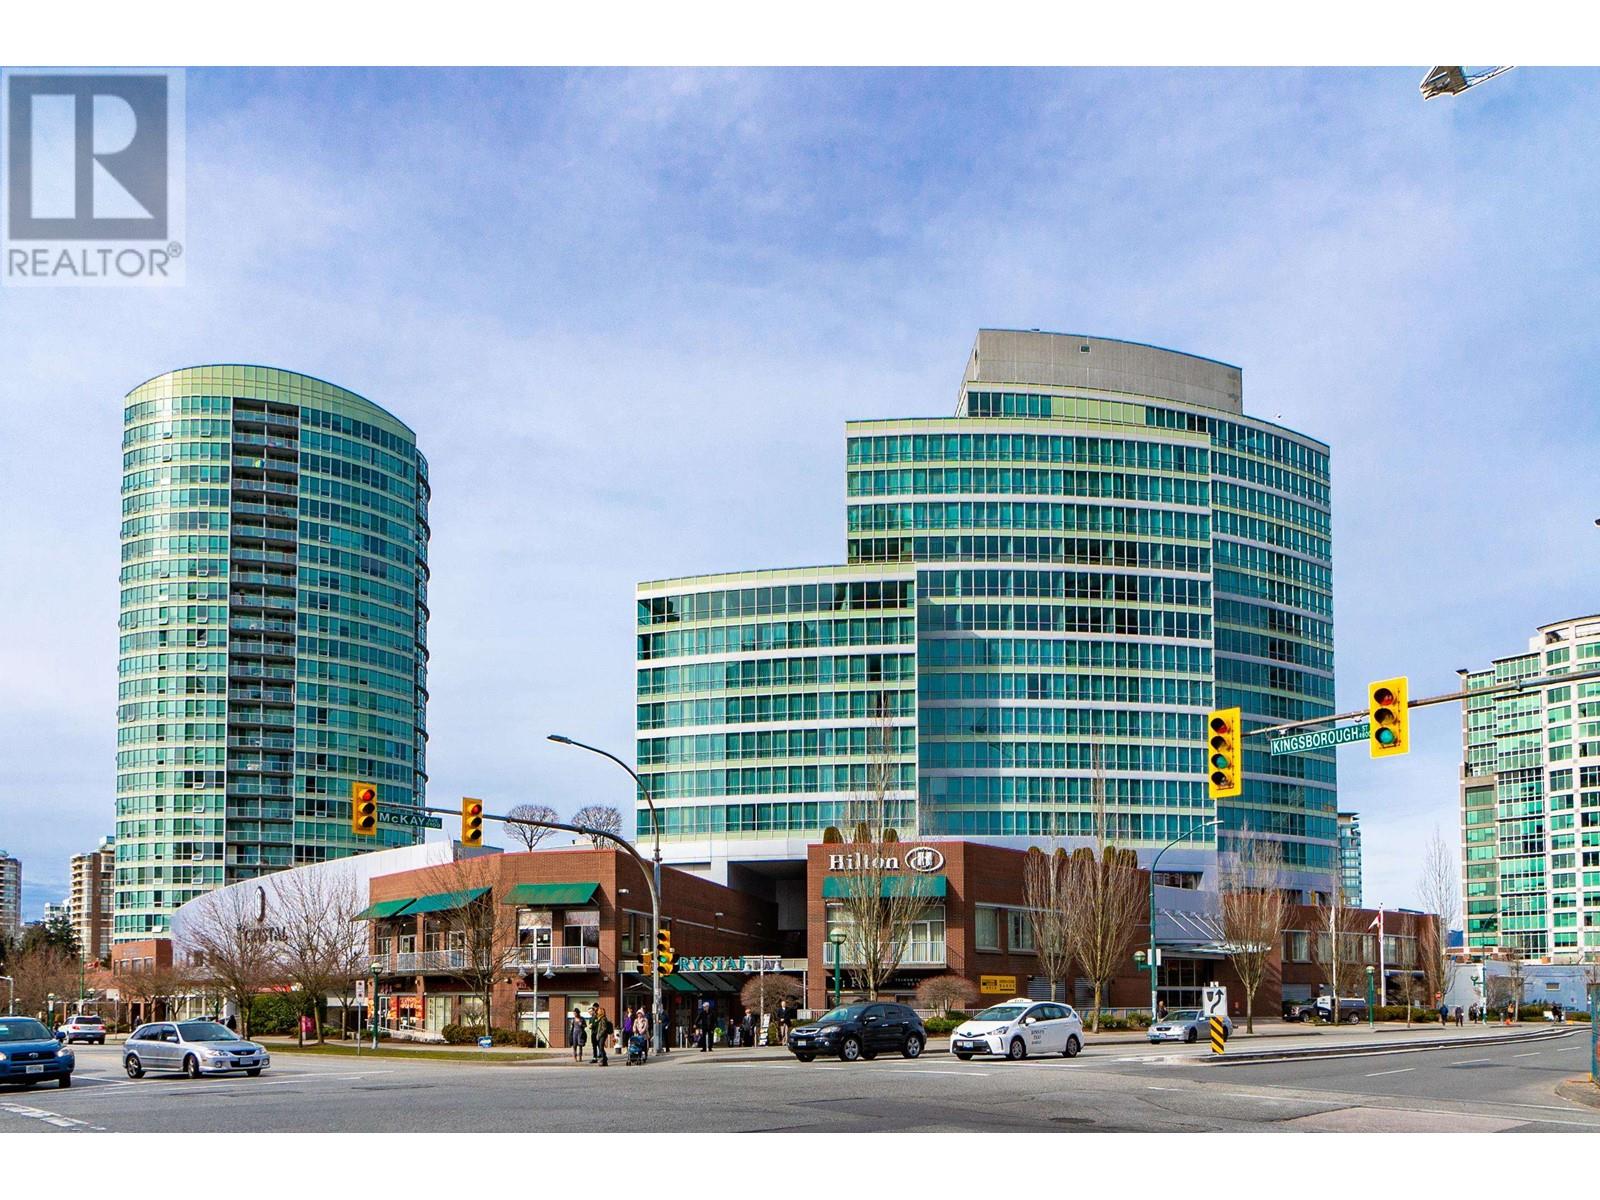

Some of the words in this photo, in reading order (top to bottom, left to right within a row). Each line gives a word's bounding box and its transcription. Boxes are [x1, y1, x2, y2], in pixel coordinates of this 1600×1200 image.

[1273, 727, 1359, 754] KINGSBOROUGH
[379, 812, 425, 826] McKAY
[828, 852, 900, 870] Hilton
[677, 956, 752, 971] RYSTAL
